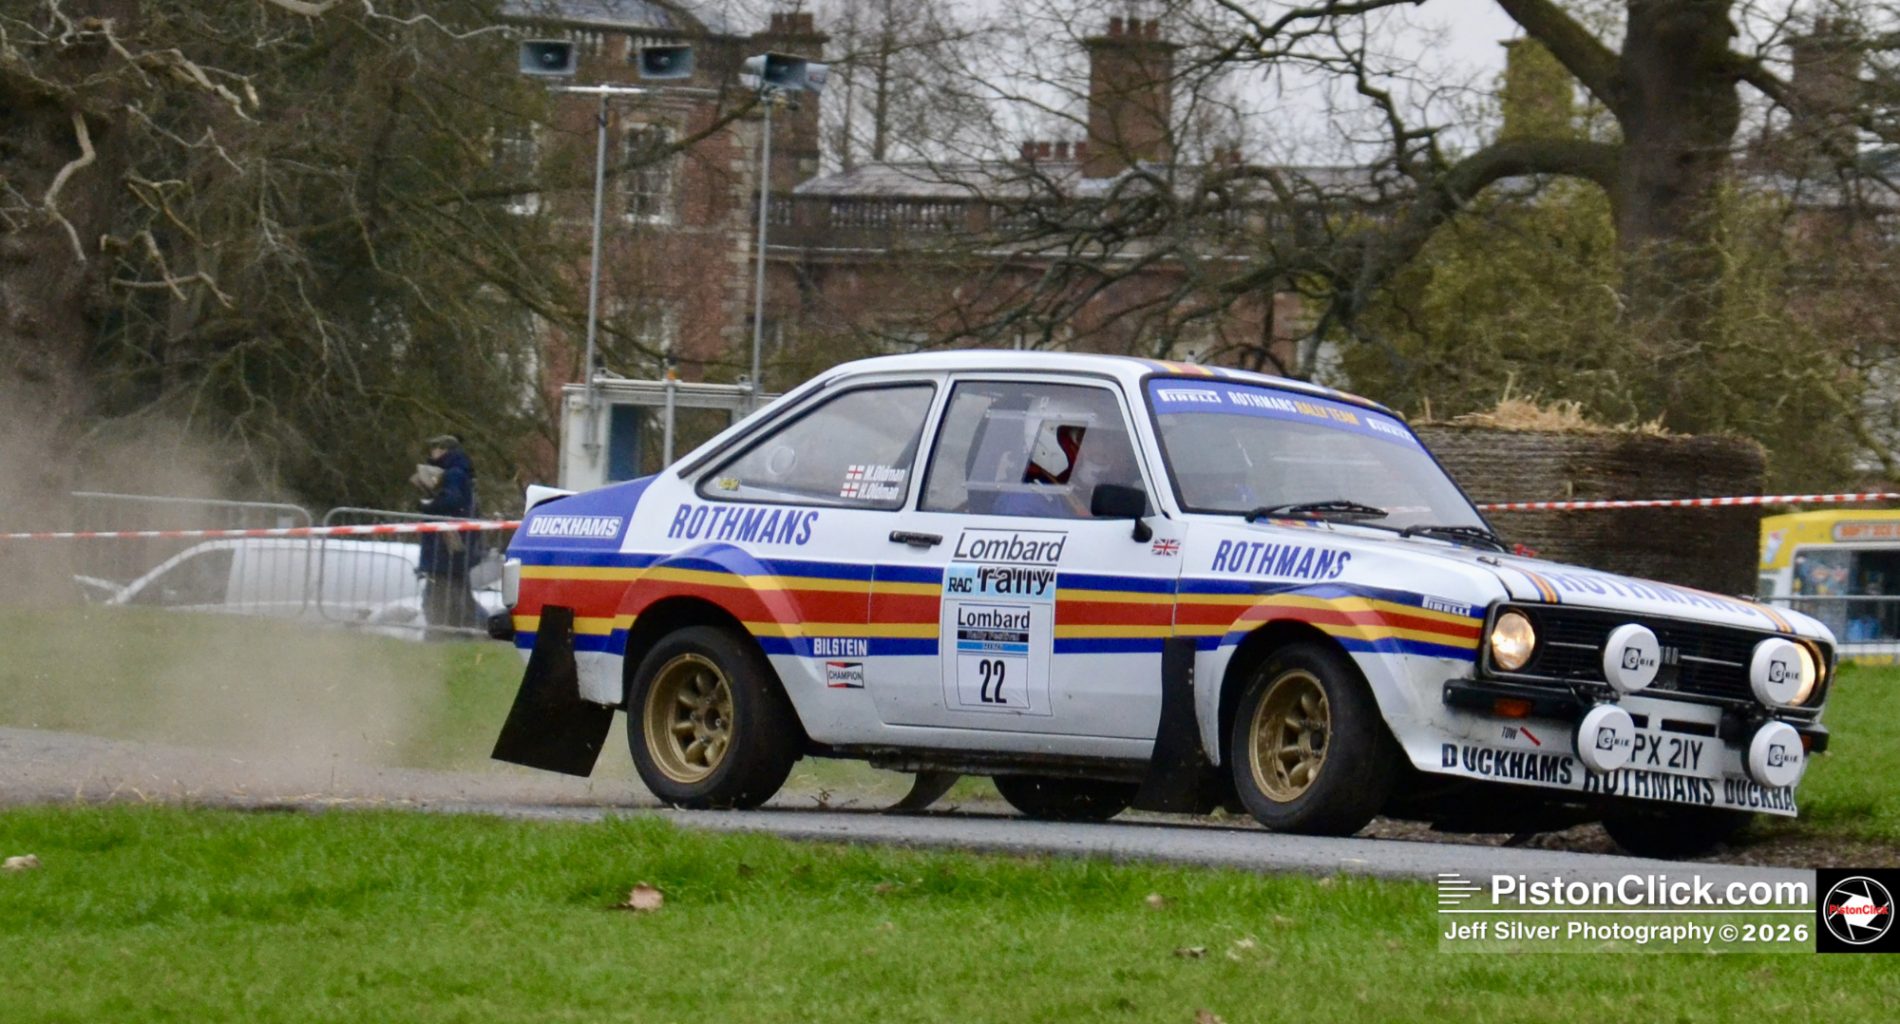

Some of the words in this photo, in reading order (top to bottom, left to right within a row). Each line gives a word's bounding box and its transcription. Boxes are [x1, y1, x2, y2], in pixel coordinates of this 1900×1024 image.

[1227, 391, 1297, 413] ROTHMANS
[1295, 401, 1329, 419] RALLY
[1328, 407, 1360, 426] TEAM
[529, 516, 620, 537] DUCKHAMS
[667, 503, 819, 546] ROTHMANS
[953, 532, 1067, 562] Lombard
[1211, 539, 1351, 580] ROTHMANS
[947, 577, 972, 593] RAC
[980, 566, 1051, 596] rally
[1551, 572, 1757, 617] ROTHMANS
[957, 607, 1031, 629] Lombard
[1422, 595, 1471, 617] PIRELLI
[813, 637, 868, 656] BILSTEIN
[828, 671, 862, 681] CHAMPION
[979, 658, 1007, 704] 22
[1501, 726, 1518, 740] TOW
[1442, 743, 1573, 785] DUCKHAMS
